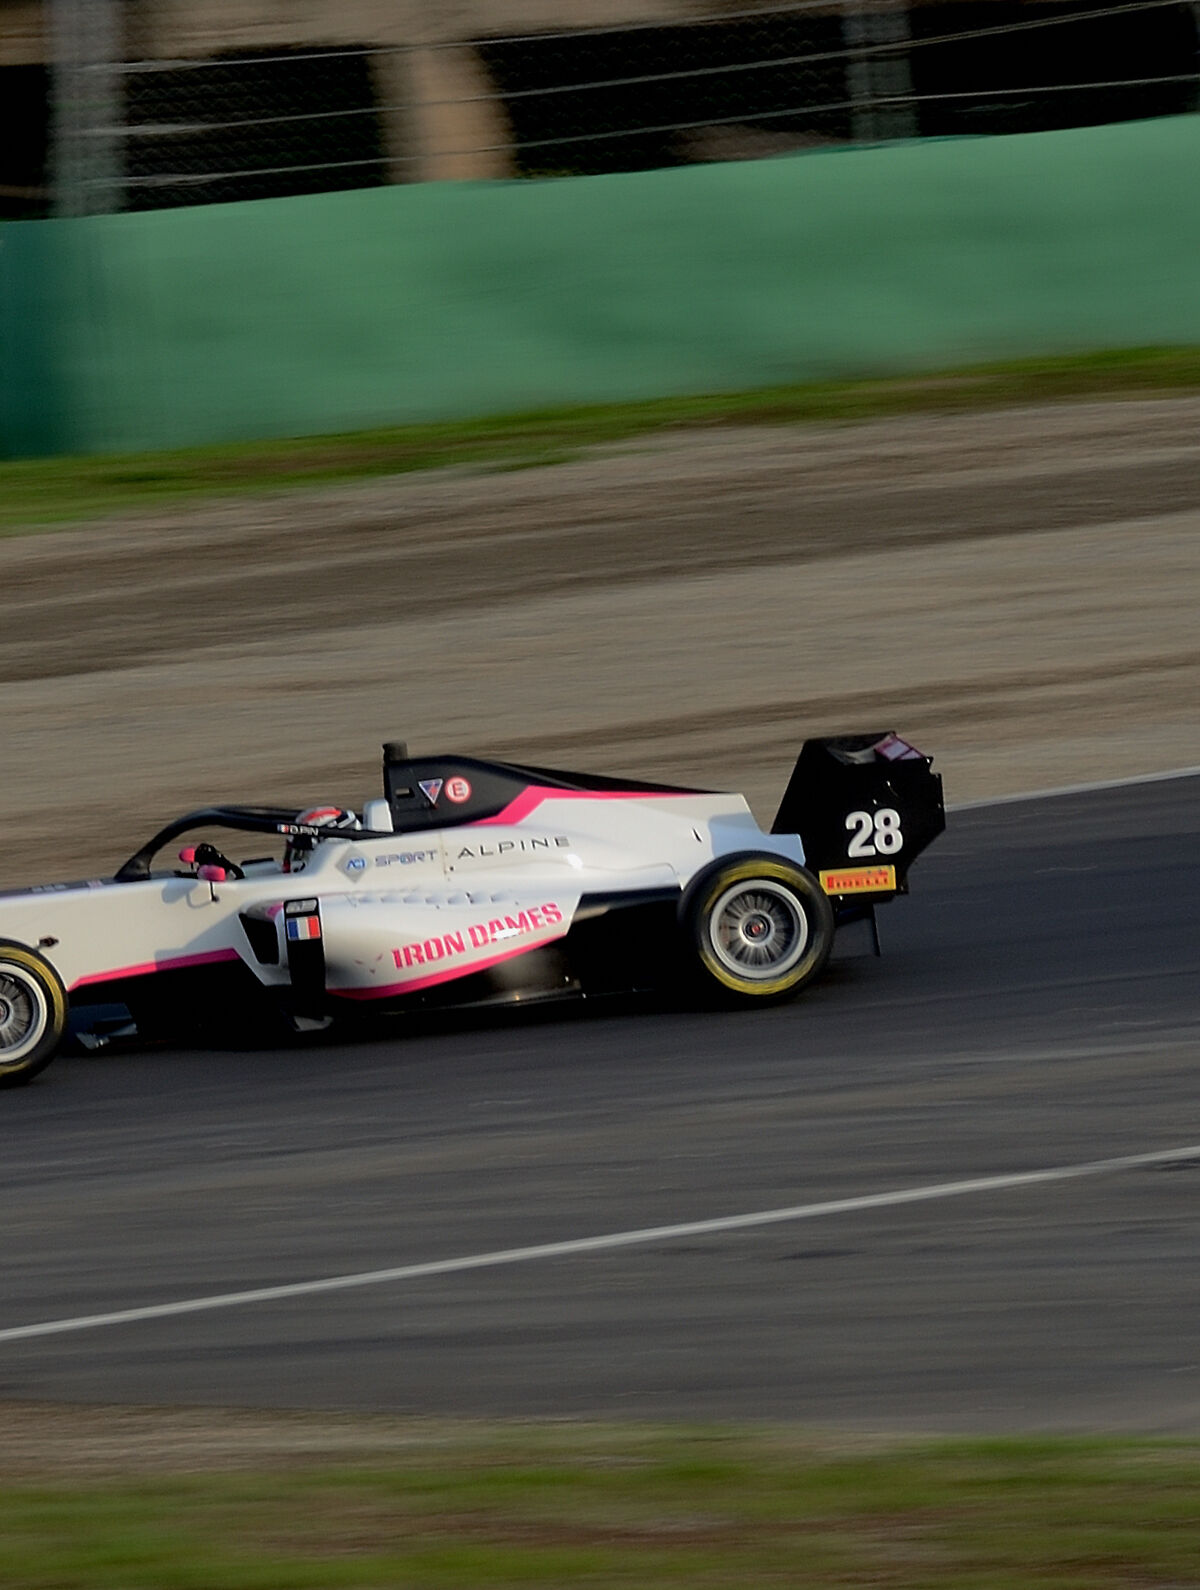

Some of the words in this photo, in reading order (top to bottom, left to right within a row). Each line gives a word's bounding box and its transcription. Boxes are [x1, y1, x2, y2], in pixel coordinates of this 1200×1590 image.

[452, 781, 465, 797] E
[845, 808, 904, 858] 28
[457, 835, 570, 859] ALPINE
[375, 849, 438, 867] SPORT
[827, 870, 889, 889] PIRELLI
[392, 930, 467, 970] IRON
[469, 902, 564, 949] DAMES
